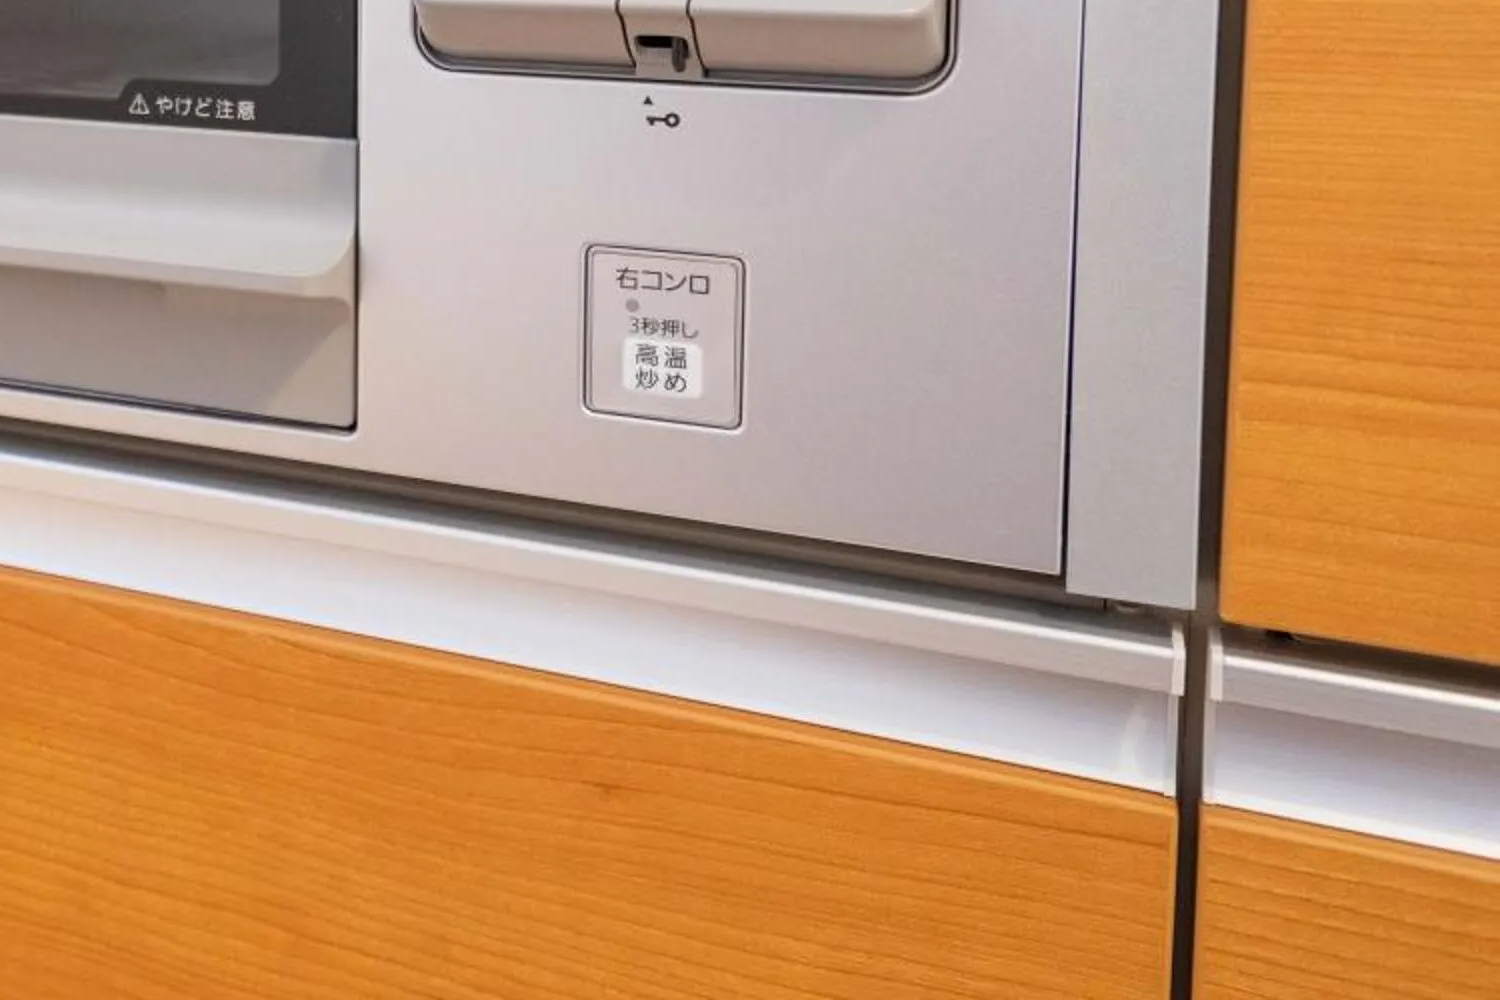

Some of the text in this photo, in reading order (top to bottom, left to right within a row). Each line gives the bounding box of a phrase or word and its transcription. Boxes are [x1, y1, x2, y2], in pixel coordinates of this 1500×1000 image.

[155, 96, 256, 121] やけど注意
[615, 266, 710, 295] 右コンロ
[629, 316, 700, 340] 3秒押し
[635, 343, 688, 369] 高温
[635, 368, 688, 393] 炒め
